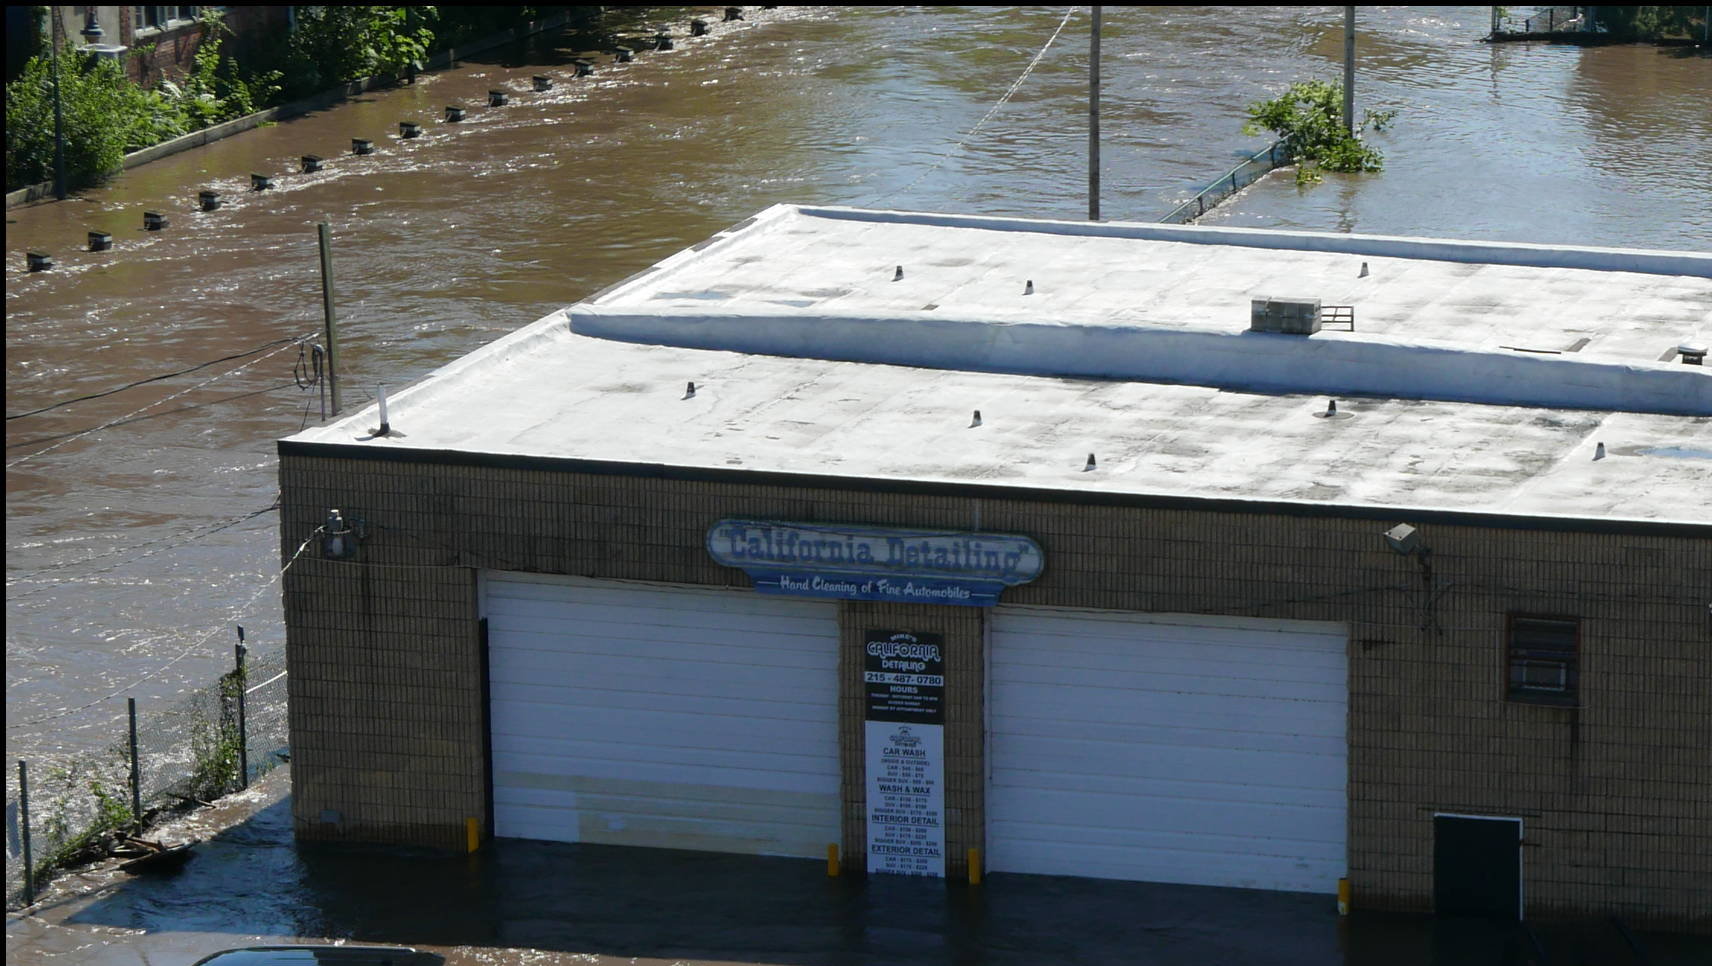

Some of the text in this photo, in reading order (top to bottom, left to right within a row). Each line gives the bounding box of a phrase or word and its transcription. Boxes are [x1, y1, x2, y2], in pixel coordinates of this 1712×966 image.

[780, 575, 970, 599] Hand Cleaning of Fine Automobiles
[868, 642, 941, 662] CALIFORNIA
[883, 660, 926, 672] DETAILING
[867, 673, 885, 682] 215
[918, 677, 941, 685] 0780
[890, 686, 918, 694] HOURS
[884, 747, 926, 757] CAR WASH
[879, 784, 903, 792] WASH
[872, 814, 939, 825] INTERIOR DETAIL
[872, 844, 941, 857] EXTERIOR DETAIL
